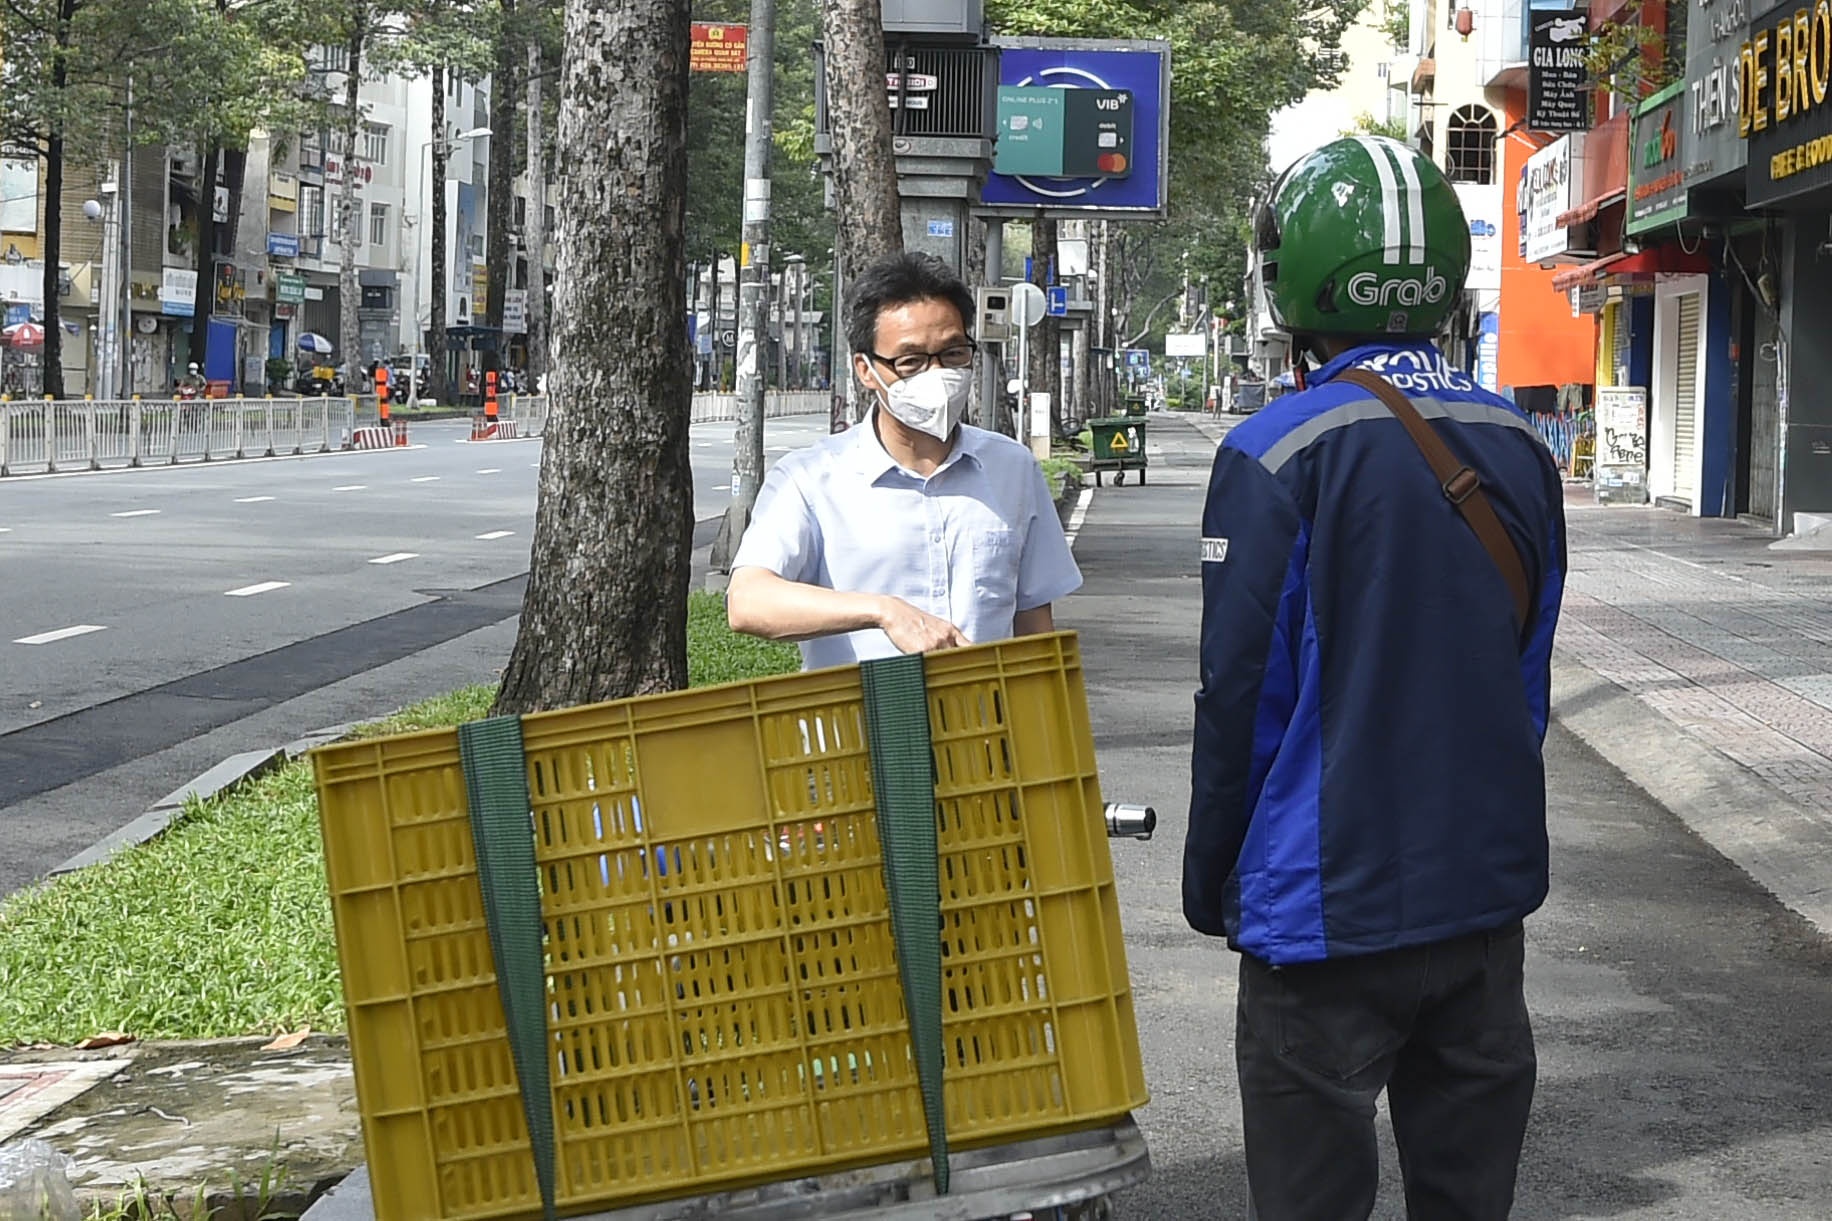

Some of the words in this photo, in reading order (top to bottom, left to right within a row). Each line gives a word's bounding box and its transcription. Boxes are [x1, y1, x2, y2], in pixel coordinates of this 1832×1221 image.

[1533, 46, 1554, 68] GIA
[1739, 29, 1768, 139] DE
[1096, 98, 1119, 110] VIB
[1557, 100, 1576, 109] Quay
[1098, 122, 1117, 130] debit
[1347, 266, 1446, 306] Grab
